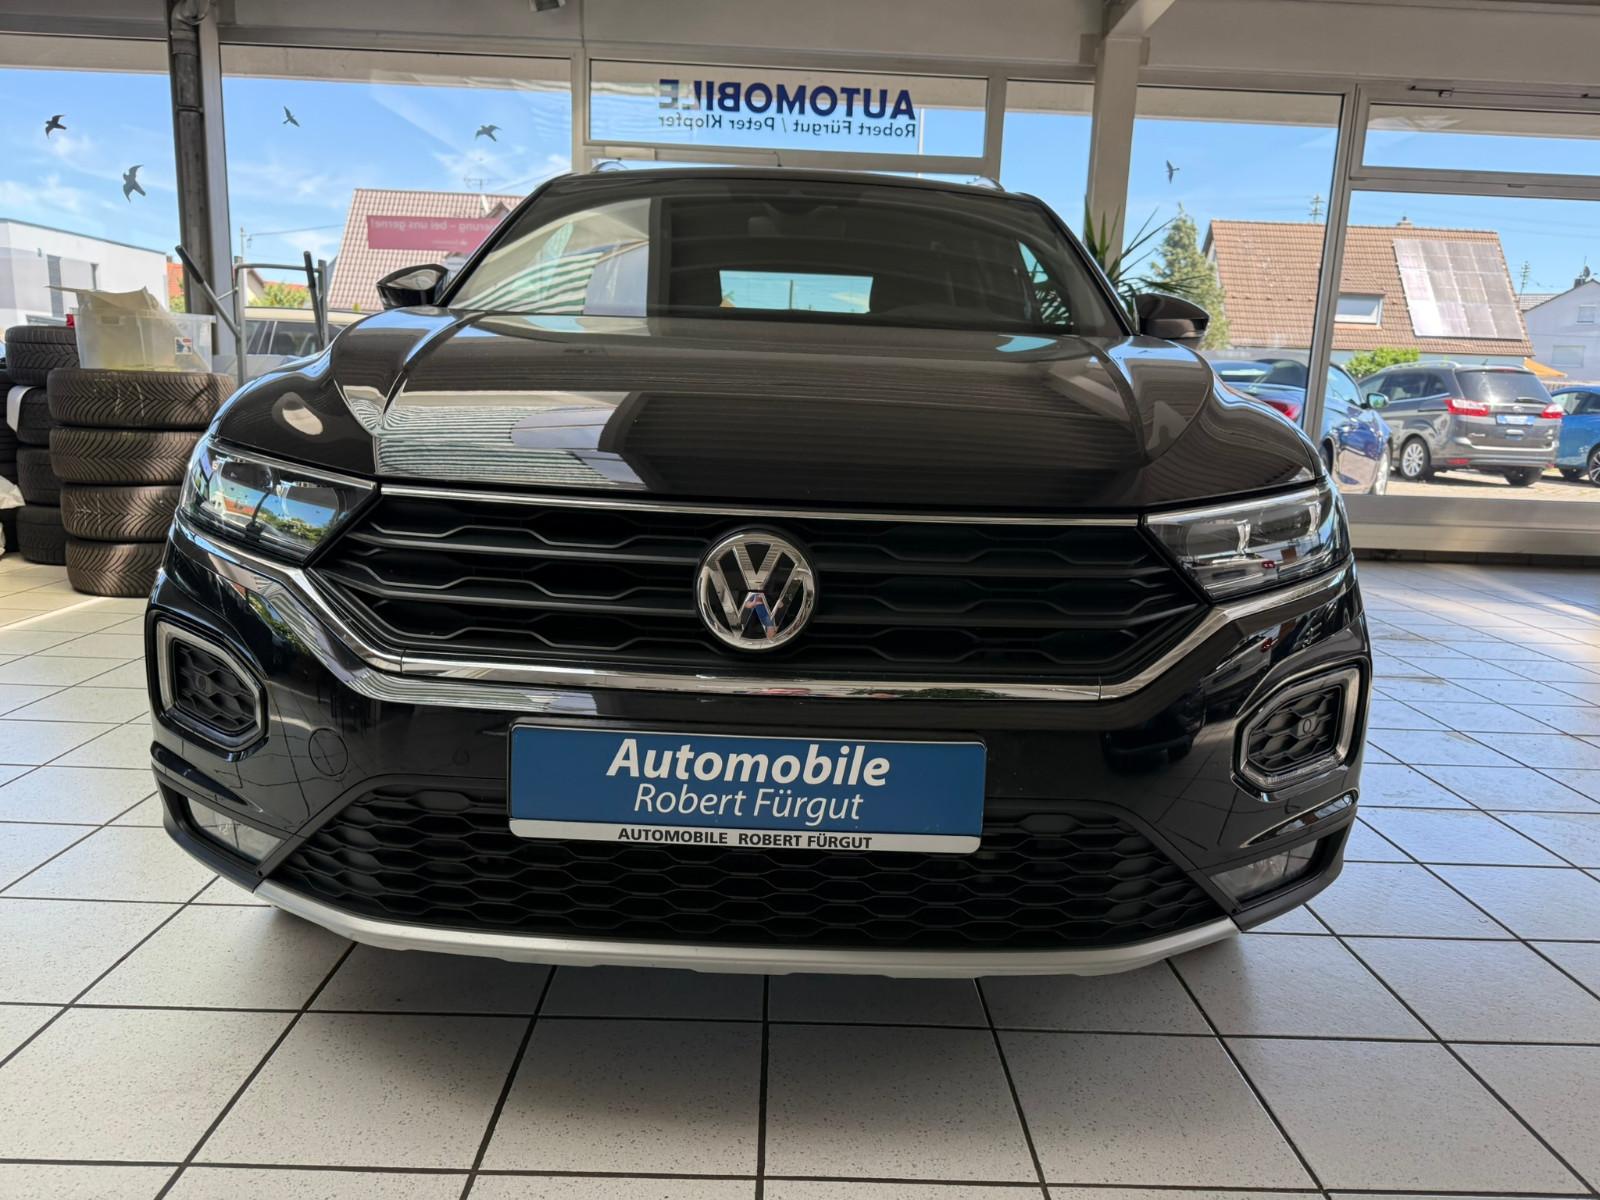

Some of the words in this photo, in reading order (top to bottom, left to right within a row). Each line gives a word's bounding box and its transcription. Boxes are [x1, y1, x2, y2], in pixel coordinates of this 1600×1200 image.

[606, 738, 890, 787] Automobile
[634, 783, 746, 816] Robert
[753, 788, 864, 826] Fürgut
[618, 828, 728, 844] AUTOMOBILE
[738, 833, 802, 847] ROBERT
[807, 833, 873, 849] FÜRGUT
